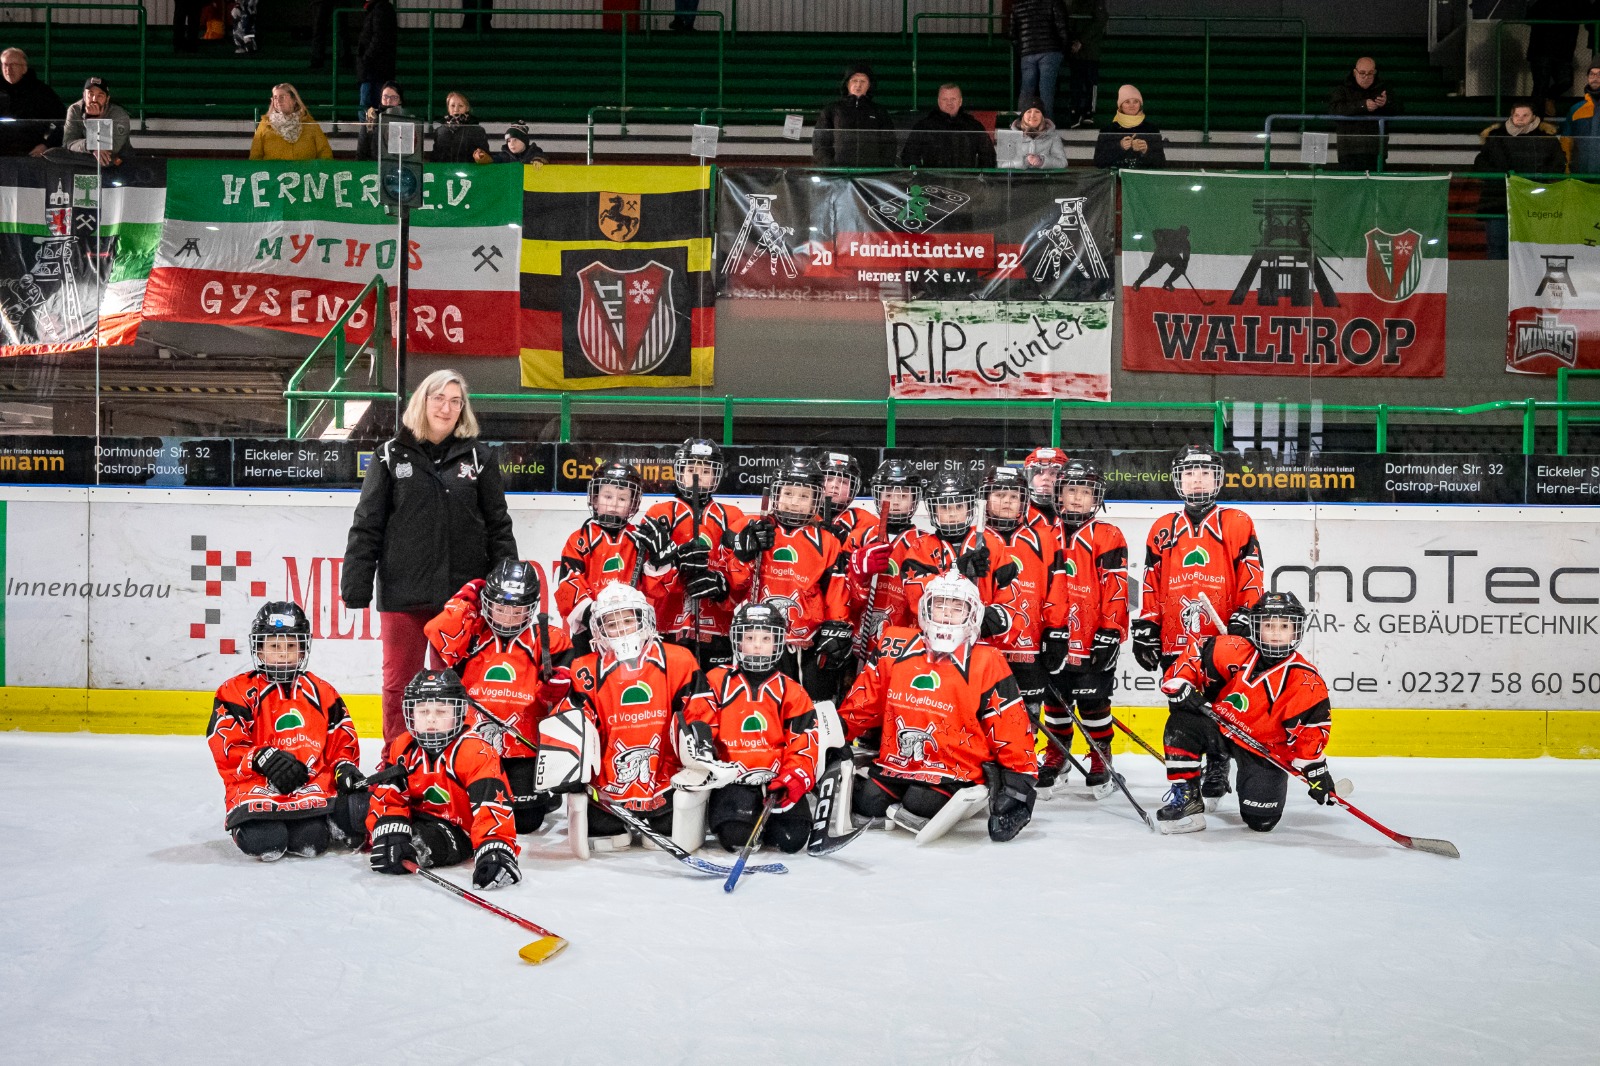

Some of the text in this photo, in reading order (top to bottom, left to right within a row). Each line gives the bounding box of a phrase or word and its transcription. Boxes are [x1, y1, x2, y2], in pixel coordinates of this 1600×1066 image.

[222, 171, 380, 208] HERNER
[1527, 210, 1563, 220] Legende
[255, 234, 423, 271] MYTHOS
[811, 240, 1019, 269] 20 Faninitiative 22
[857, 270, 971, 283] Herner EV e.V.
[1152, 313, 1416, 366] WALTROP
[1517, 327, 1575, 359] MINERS
[975, 314, 1084, 383] Günter
[94, 446, 211, 459] Dortmunder Str. 32
[245, 449, 339, 462] Eickeler Str. 25
[0, 455, 65, 471] mann
[94, 463, 188, 477] Castrop-Rauxel
[944, 460, 965, 471] Str.
[970, 459, 985, 471] 25
[1385, 463, 1504, 475] Dortmunder Str. 32
[244, 465, 323, 478] Herne-Eickel
[1537, 466, 1600, 478] Eickeler S
[1385, 480, 1480, 493] Castrop-Rauxel
[6, 577, 172, 599] Innenausbau
[1306, 611, 1598, 635] ÄR- & GEBÄUDETECHNIK
[821, 629, 852, 639] AUER
[879, 636, 907, 659] 25
[577, 667, 596, 692] 3
[1402, 671, 1485, 694] 02327
[1491, 671, 1522, 694] 58
[1531, 671, 1562, 694] 60
[1571, 671, 1600, 694] 50
[480, 687, 534, 701] Vogelbusch
[887, 688, 902, 701] Gut
[535, 754, 547, 786] CCM
[248, 798, 327, 812] ICE ALIENS
[1242, 799, 1279, 809] BAUER
